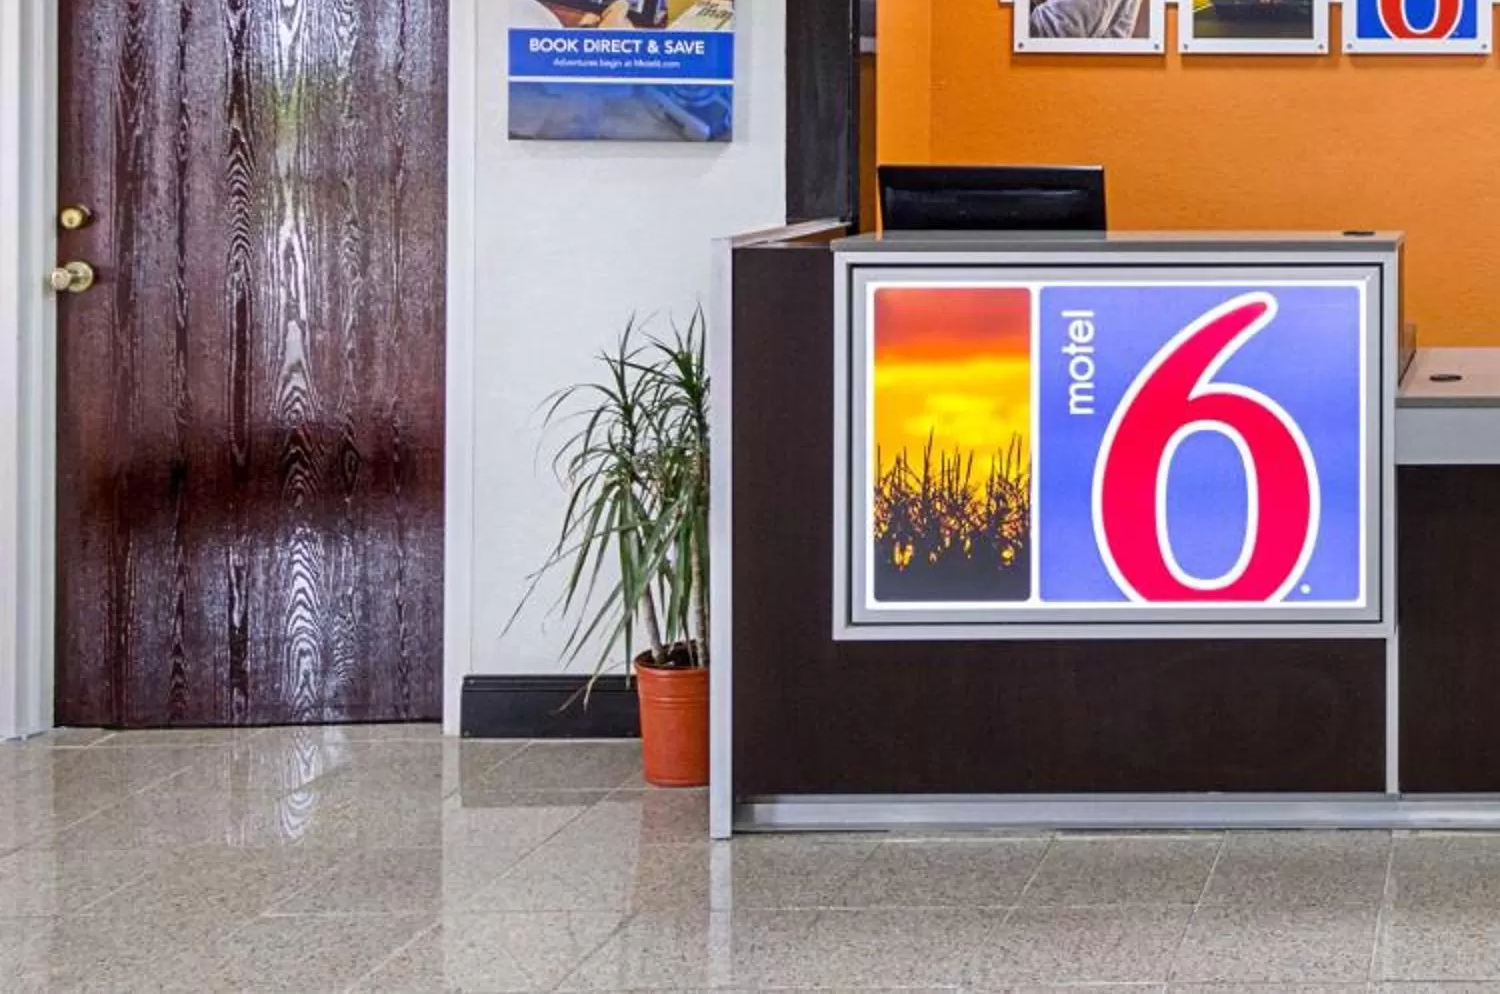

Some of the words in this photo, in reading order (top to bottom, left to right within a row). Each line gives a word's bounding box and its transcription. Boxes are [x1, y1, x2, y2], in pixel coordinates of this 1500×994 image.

[529, 37, 579, 53] BOOK
[583, 38, 643, 53] DIRECT
[647, 39, 659, 54] &
[663, 40, 705, 55] SAVE
[1061, 309, 1094, 415] motel
[1092, 291, 1321, 603] 6
